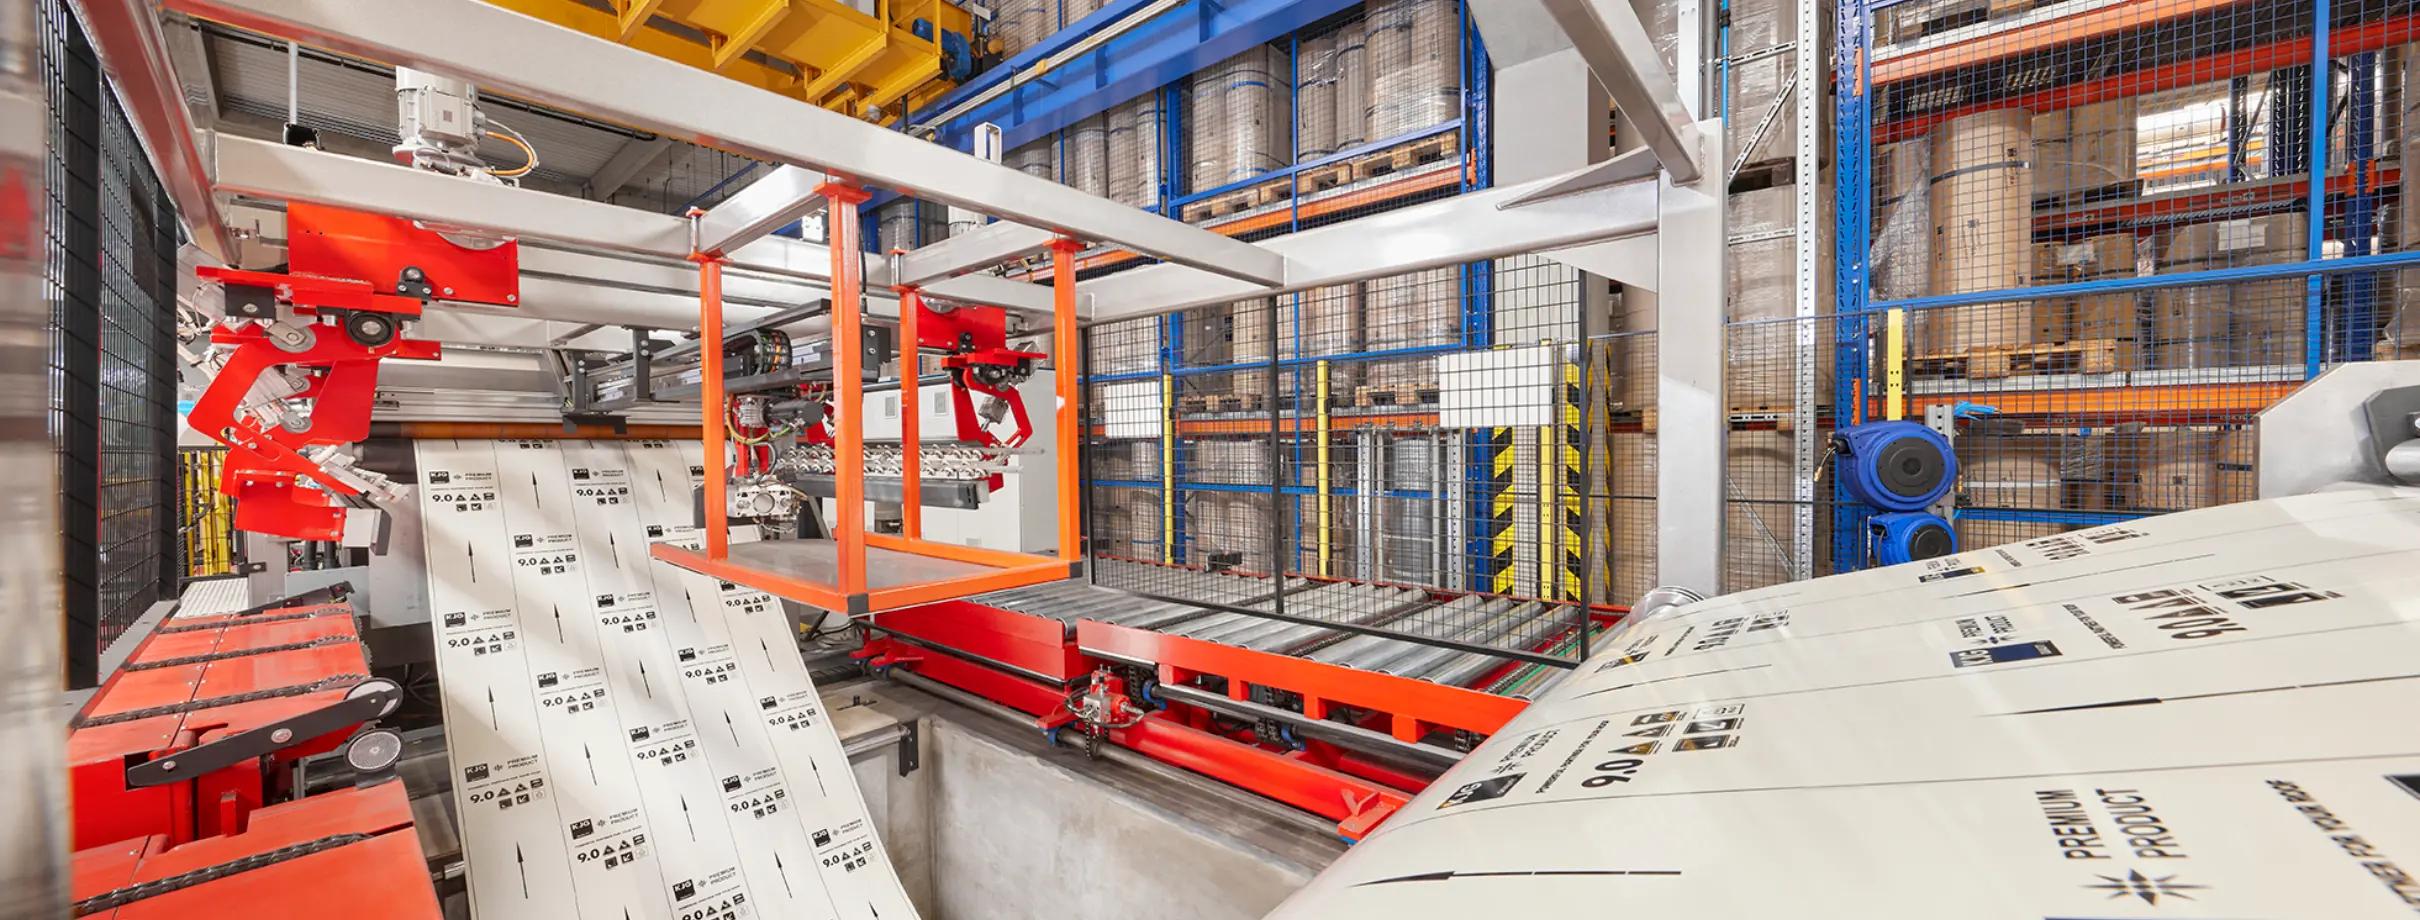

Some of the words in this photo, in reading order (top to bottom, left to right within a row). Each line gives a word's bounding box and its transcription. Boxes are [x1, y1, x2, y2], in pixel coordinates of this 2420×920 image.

[432, 494, 453, 503] 9.0
[576, 488, 594, 497] 9.0
[518, 556, 538, 567] 9.0
[602, 616, 620, 626] 9.0
[2171, 617, 2247, 639] 9.0
[448, 637, 470, 648] 9.0
[685, 669, 702, 679] 9.0
[543, 696, 563, 708] 9.0
[769, 716, 785, 726] 9.0
[637, 749, 656, 760] 9.0
[1581, 758, 1643, 788] 9.0
[470, 790, 494, 804] 9.0
[2265, 779, 2316, 803] ROOF
[731, 800, 749, 813] 9.0
[2035, 789, 2112, 859] PREMIUM
[2095, 788, 2190, 858] PRODUCT
[577, 848, 600, 863] 9.0
[822, 854, 840, 868] 9.0
